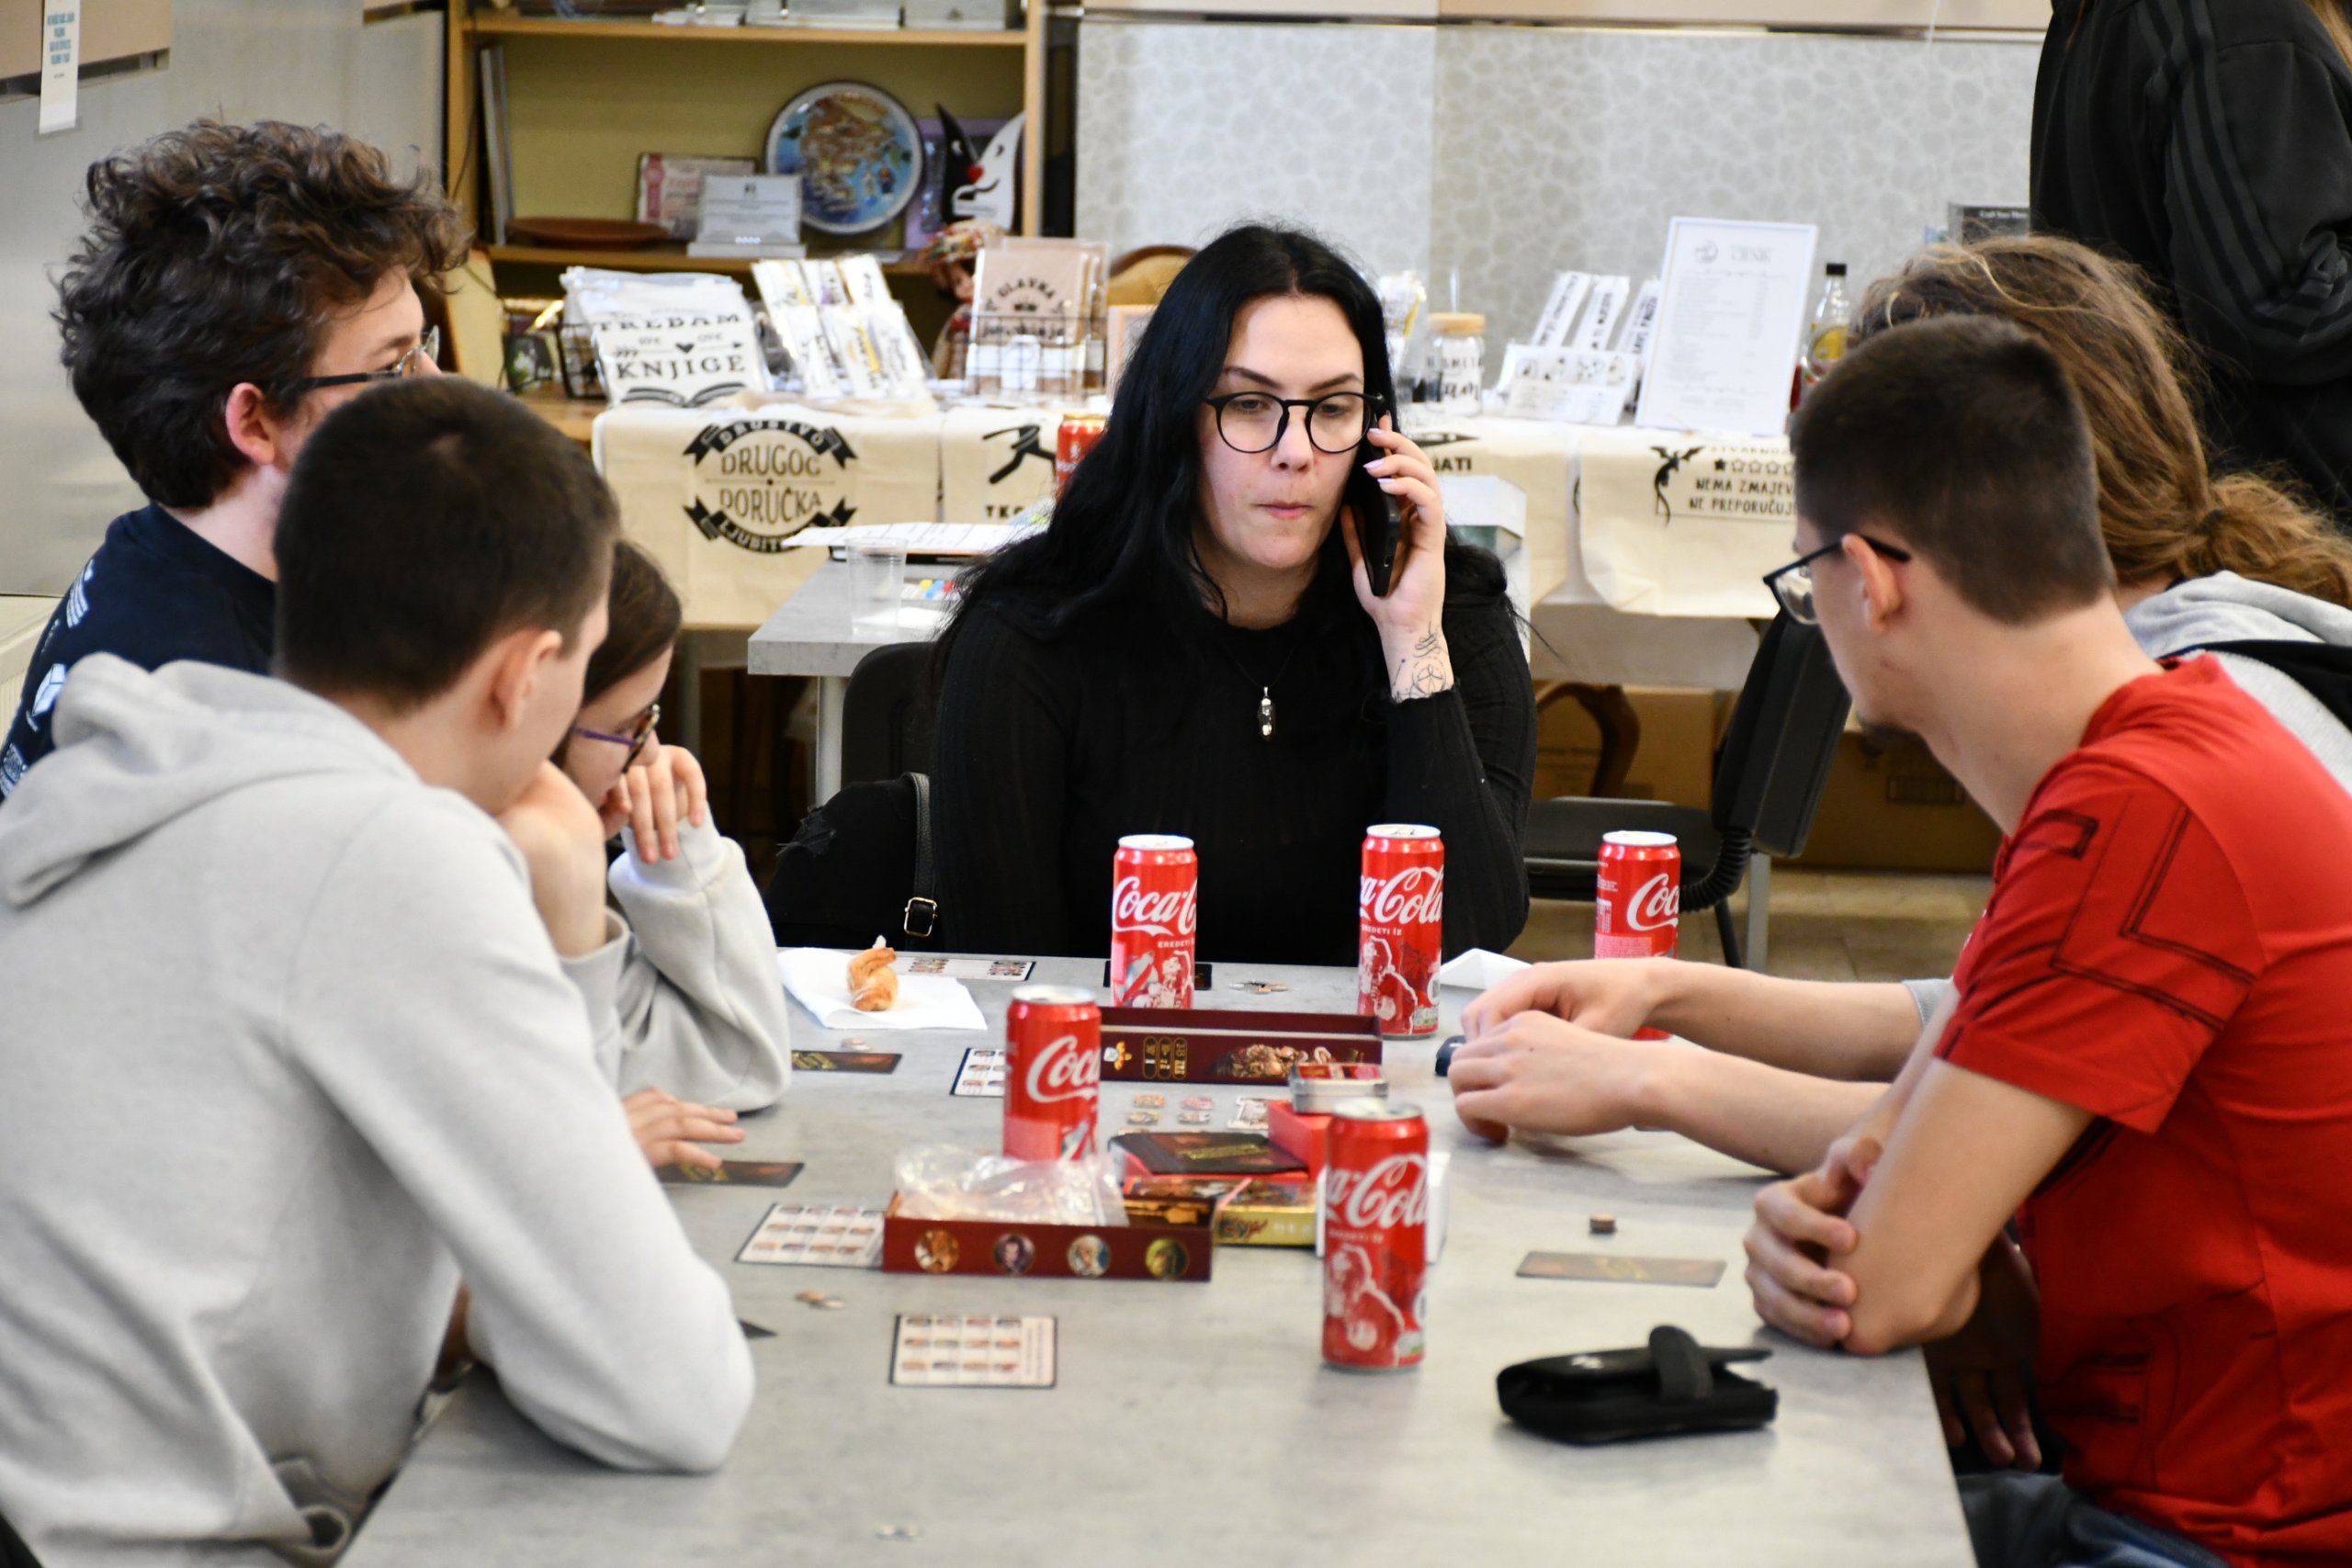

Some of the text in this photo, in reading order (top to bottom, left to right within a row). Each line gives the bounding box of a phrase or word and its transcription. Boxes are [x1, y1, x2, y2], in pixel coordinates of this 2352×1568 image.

[616, 355, 746, 380] KNJIGE
[1696, 478, 1794, 496] NEMA ZMAJEV
[1690, 497, 1796, 516] NE PREPORUČUJ
[719, 518, 787, 552] LJUBIT
